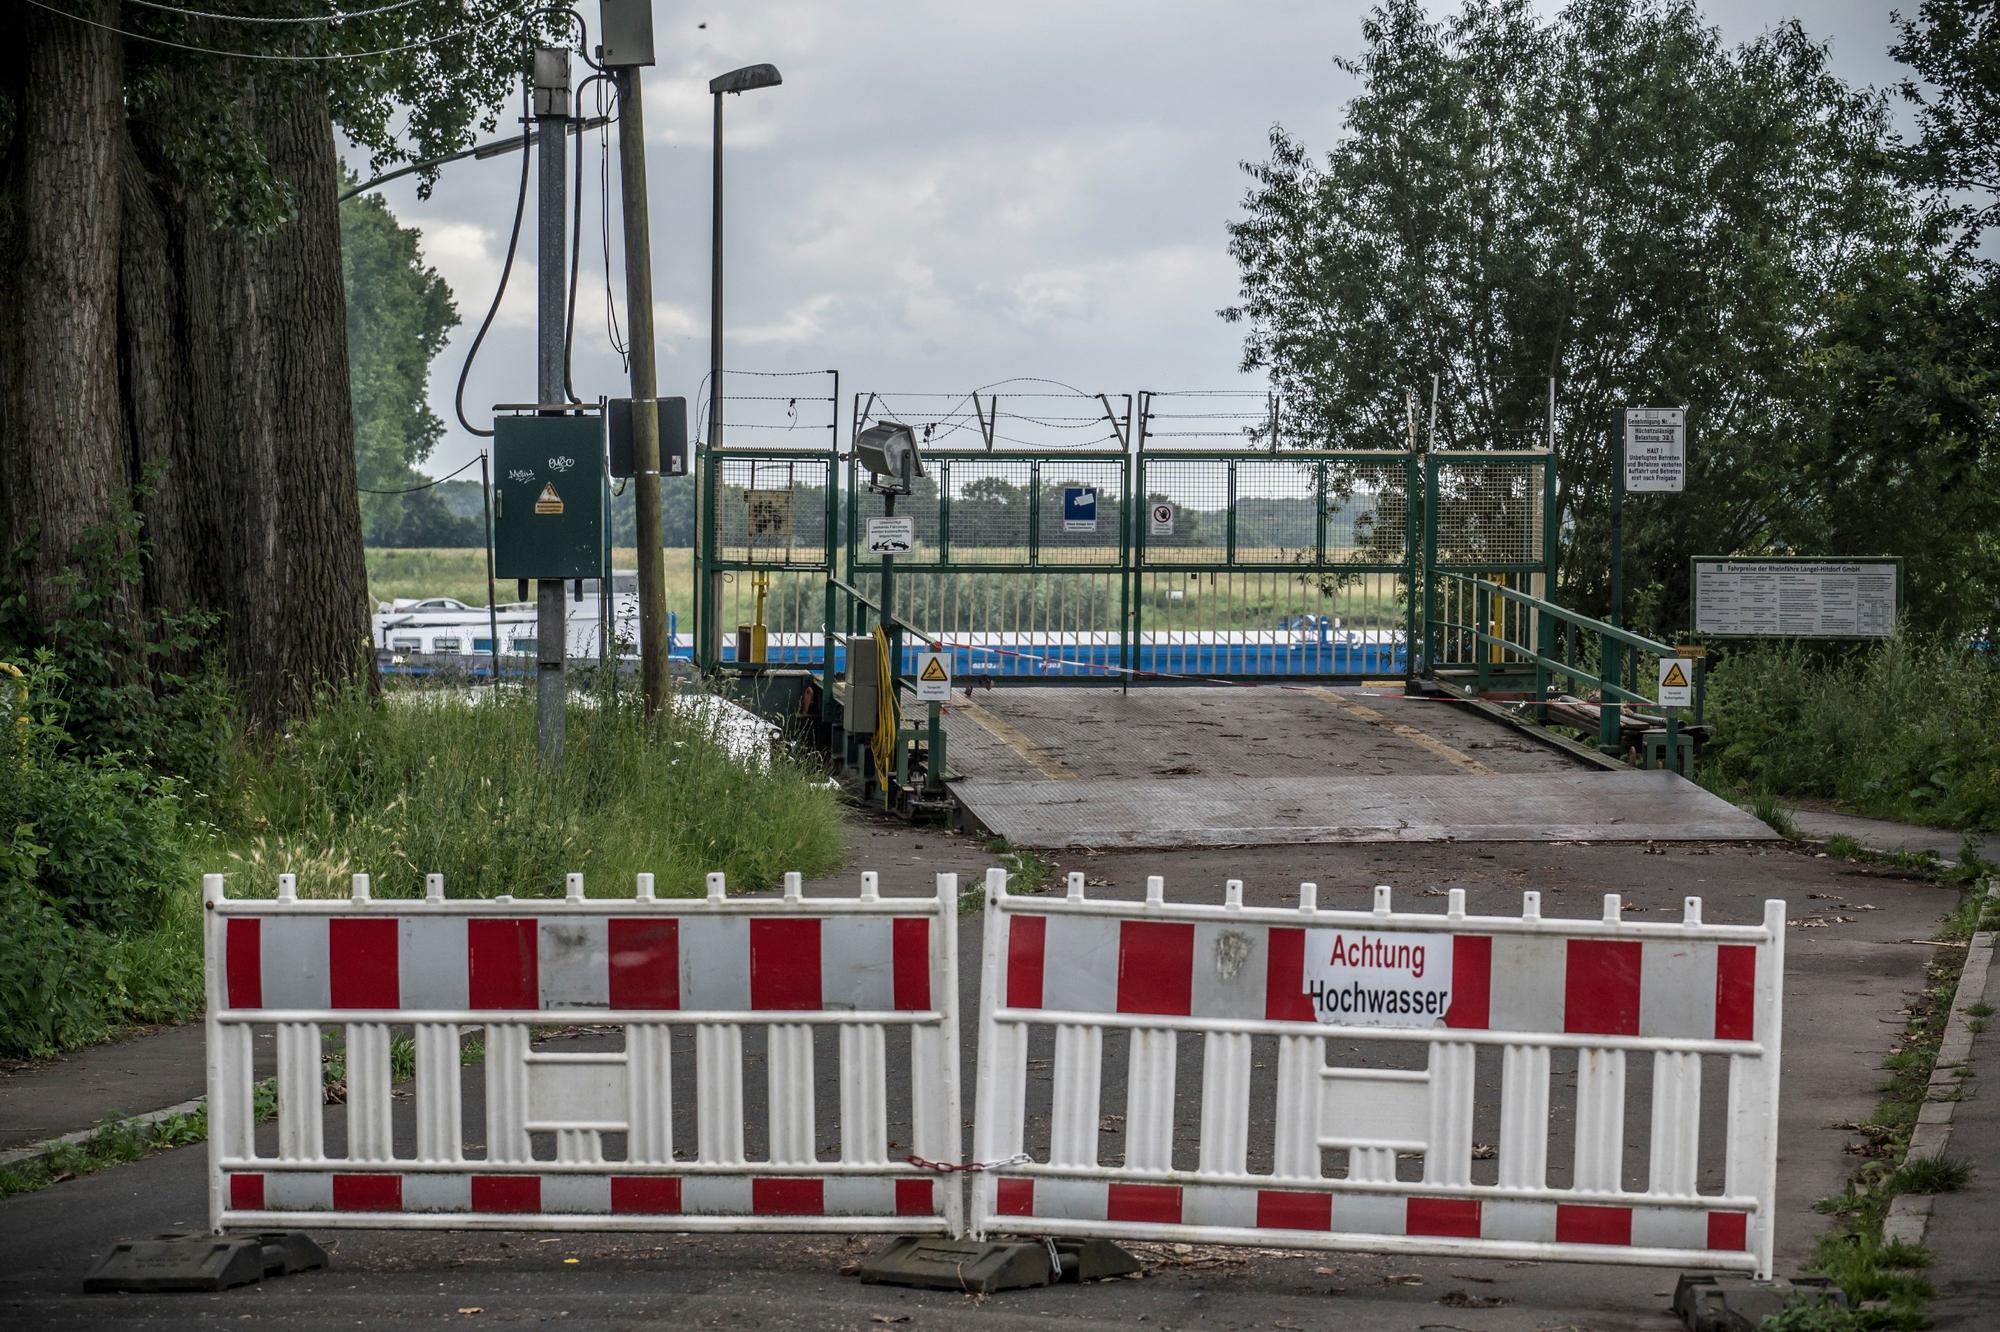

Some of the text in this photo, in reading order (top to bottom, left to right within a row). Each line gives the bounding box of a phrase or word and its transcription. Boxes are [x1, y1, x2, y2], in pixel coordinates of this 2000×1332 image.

[1628, 454, 1657, 462] Unbefugtes
[1727, 565, 1757, 573] Fahrpreise
[1841, 565, 1860, 573] GmbH
[1330, 934, 1425, 978] Achtung
[1310, 979, 1448, 1015] Hochwasser
